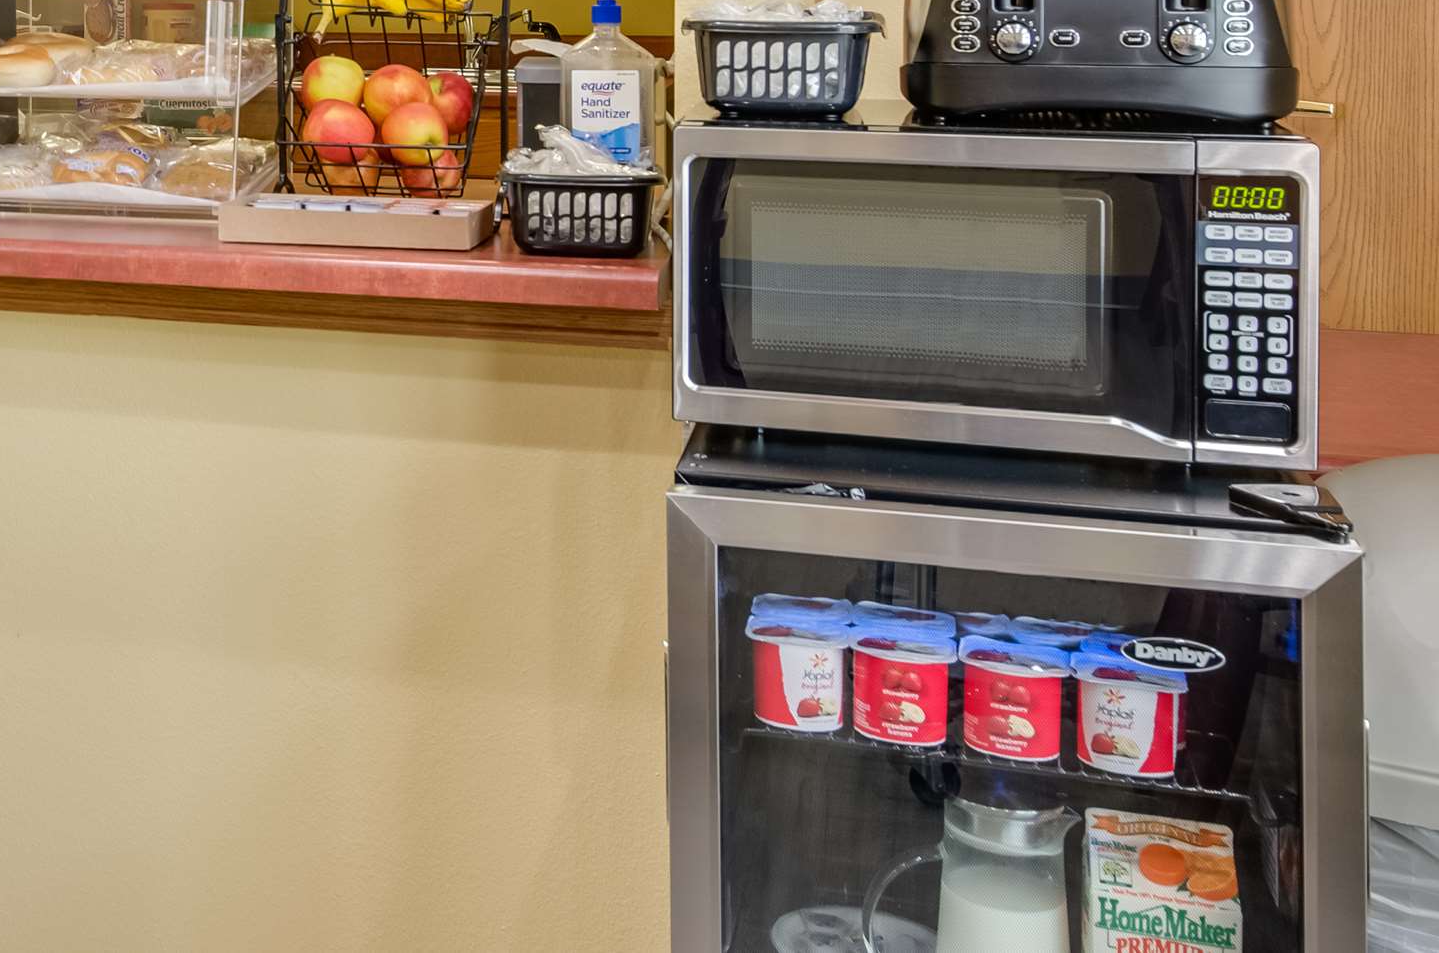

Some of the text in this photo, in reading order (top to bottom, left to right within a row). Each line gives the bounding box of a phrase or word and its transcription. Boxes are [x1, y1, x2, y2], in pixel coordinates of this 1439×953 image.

[581, 81, 622, 93] equate
[581, 97, 611, 107] Hand
[581, 108, 630, 119] Sanitizer
[1212, 185, 1286, 210] 00:00
[1207, 210, 1288, 221] Hamilton Beach
[1135, 642, 1213, 668] Danby
[1117, 822, 1199, 844] ORIGINAL
[1095, 896, 1237, 948] HomeMaker
